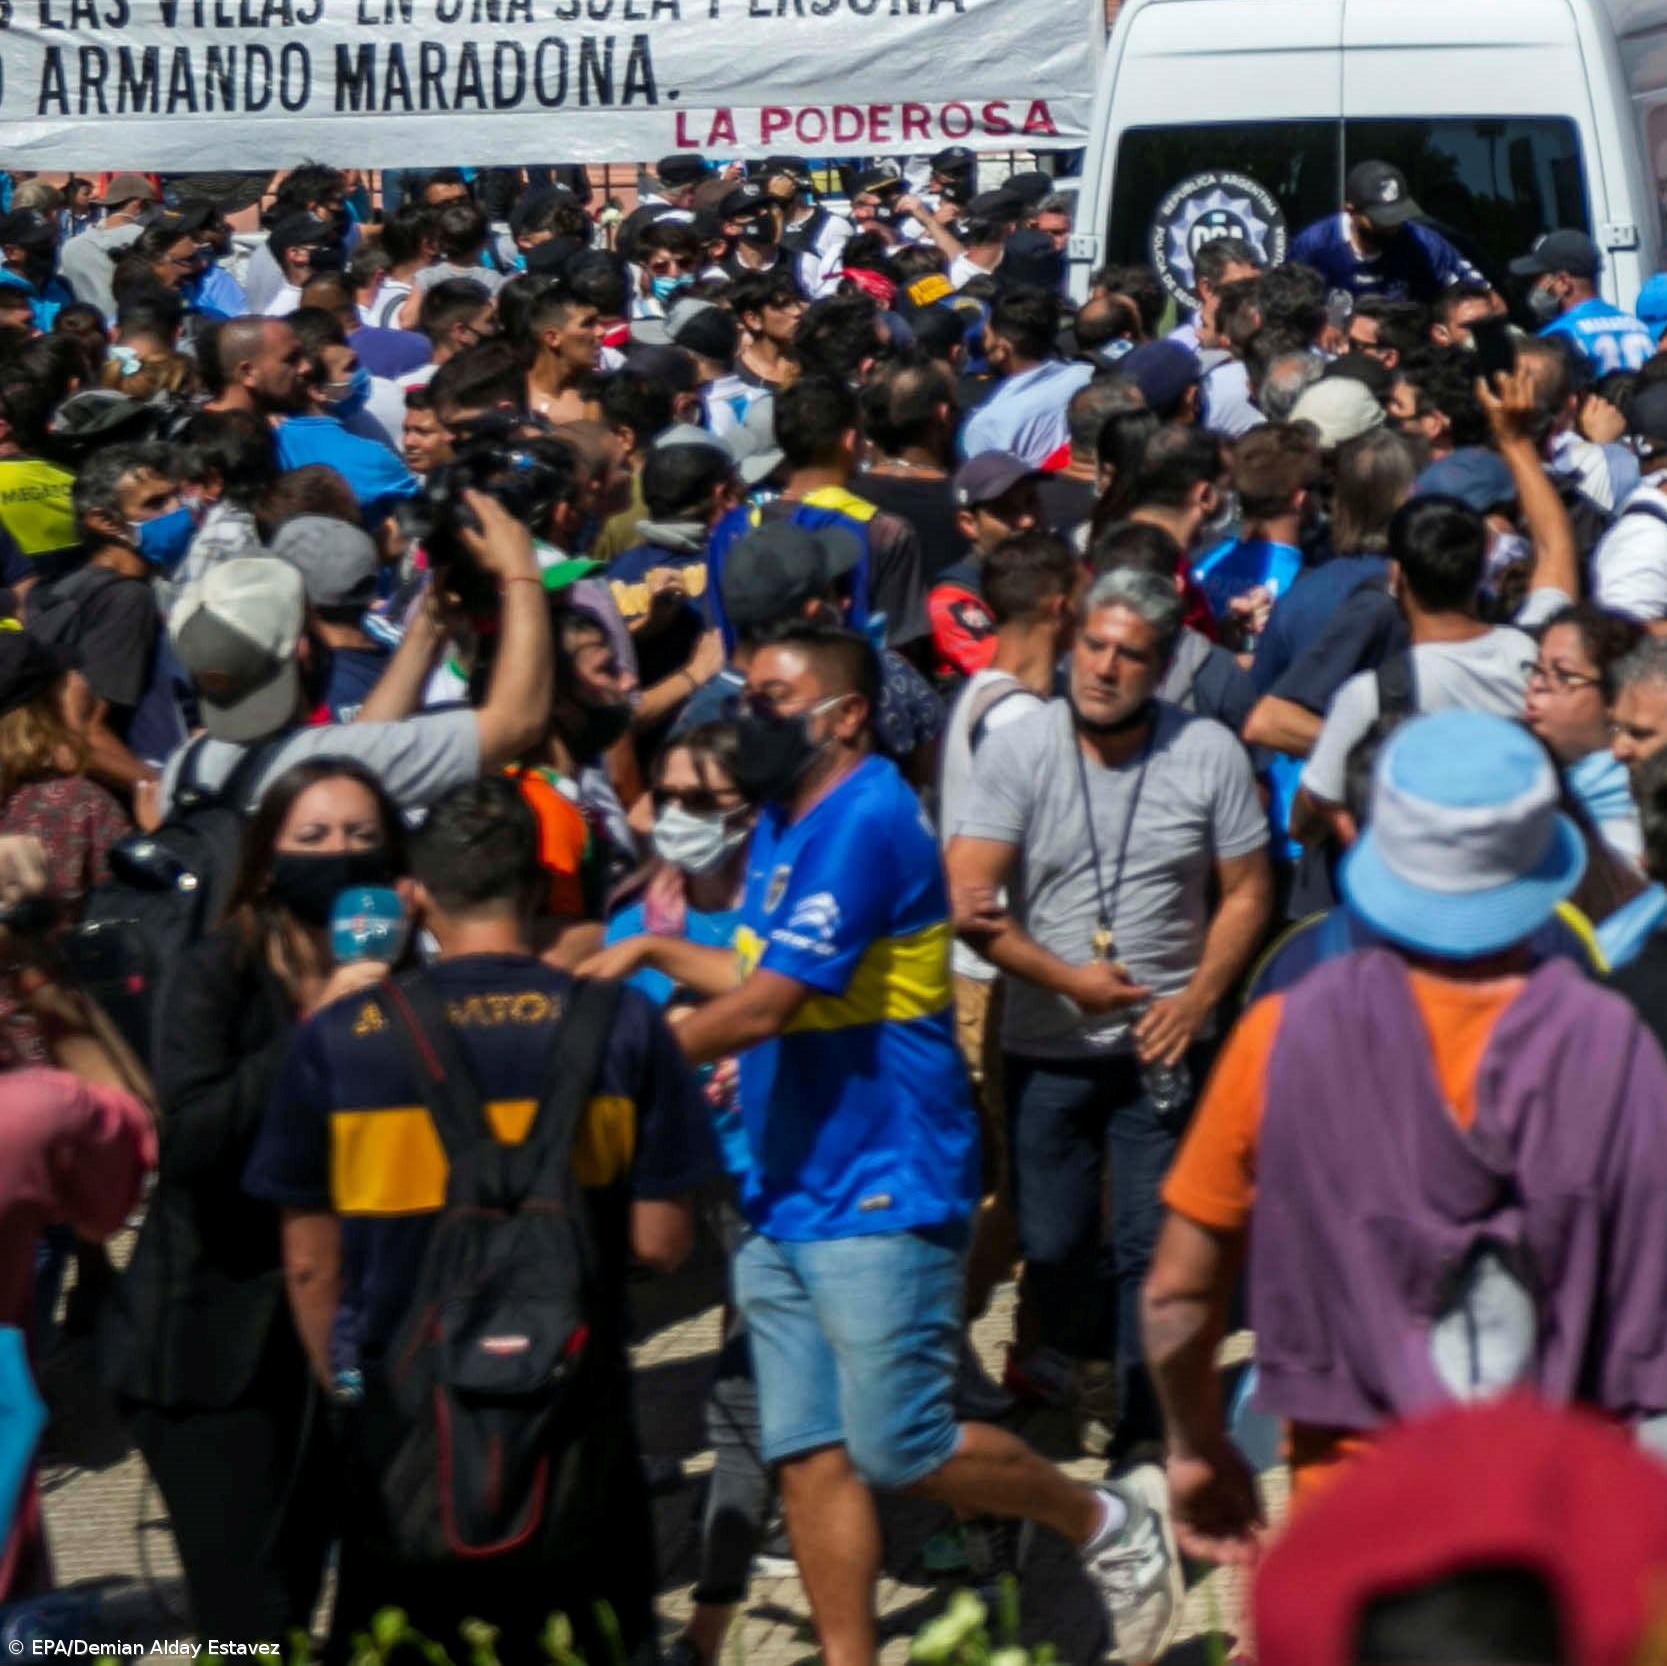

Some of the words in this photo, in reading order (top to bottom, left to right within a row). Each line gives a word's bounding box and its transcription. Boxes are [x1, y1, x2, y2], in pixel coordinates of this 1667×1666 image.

[38, 42, 312, 116] ARMANDO
[335, 34, 680, 112] MARADONA.
[675, 108, 737, 148] LA
[760, 98, 1059, 145] PODEROSA
